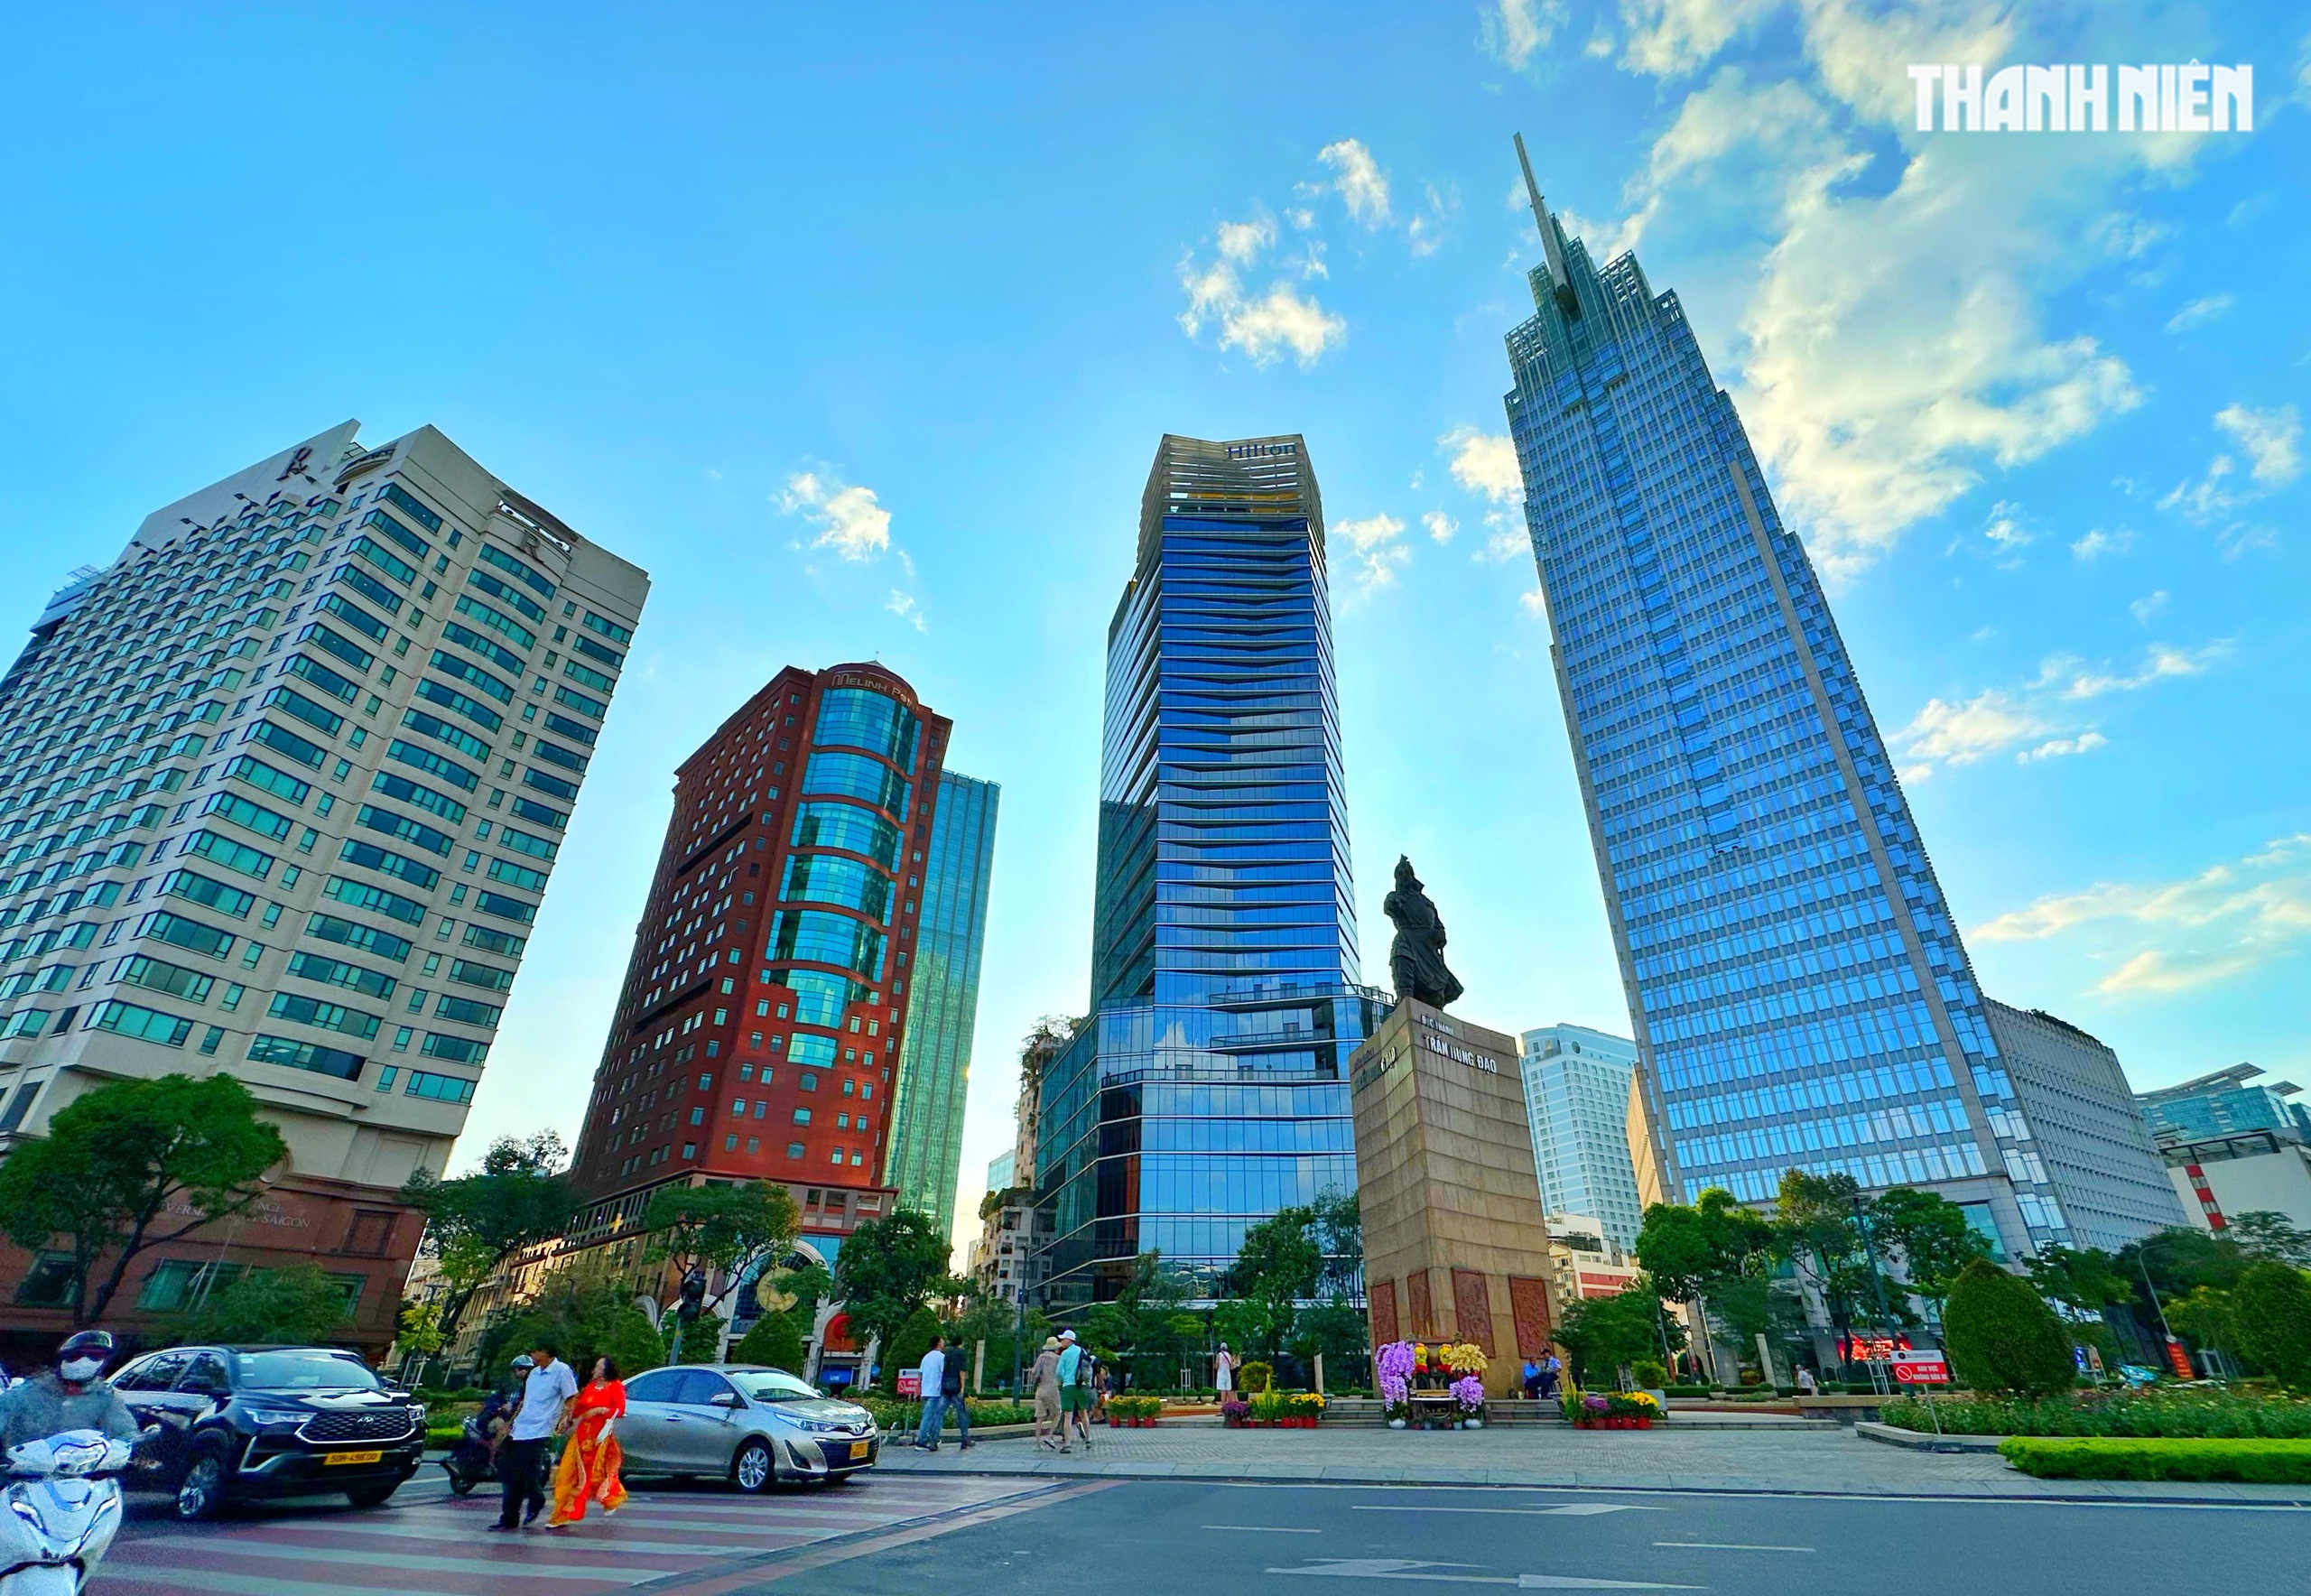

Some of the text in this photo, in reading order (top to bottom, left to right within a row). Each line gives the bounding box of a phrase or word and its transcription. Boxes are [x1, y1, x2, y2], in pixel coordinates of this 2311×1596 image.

[1227, 443, 1296, 459] Hilton
[1477, 1054, 1498, 1075] ĐẠO
[263, 1213, 311, 1228] SAIGON
